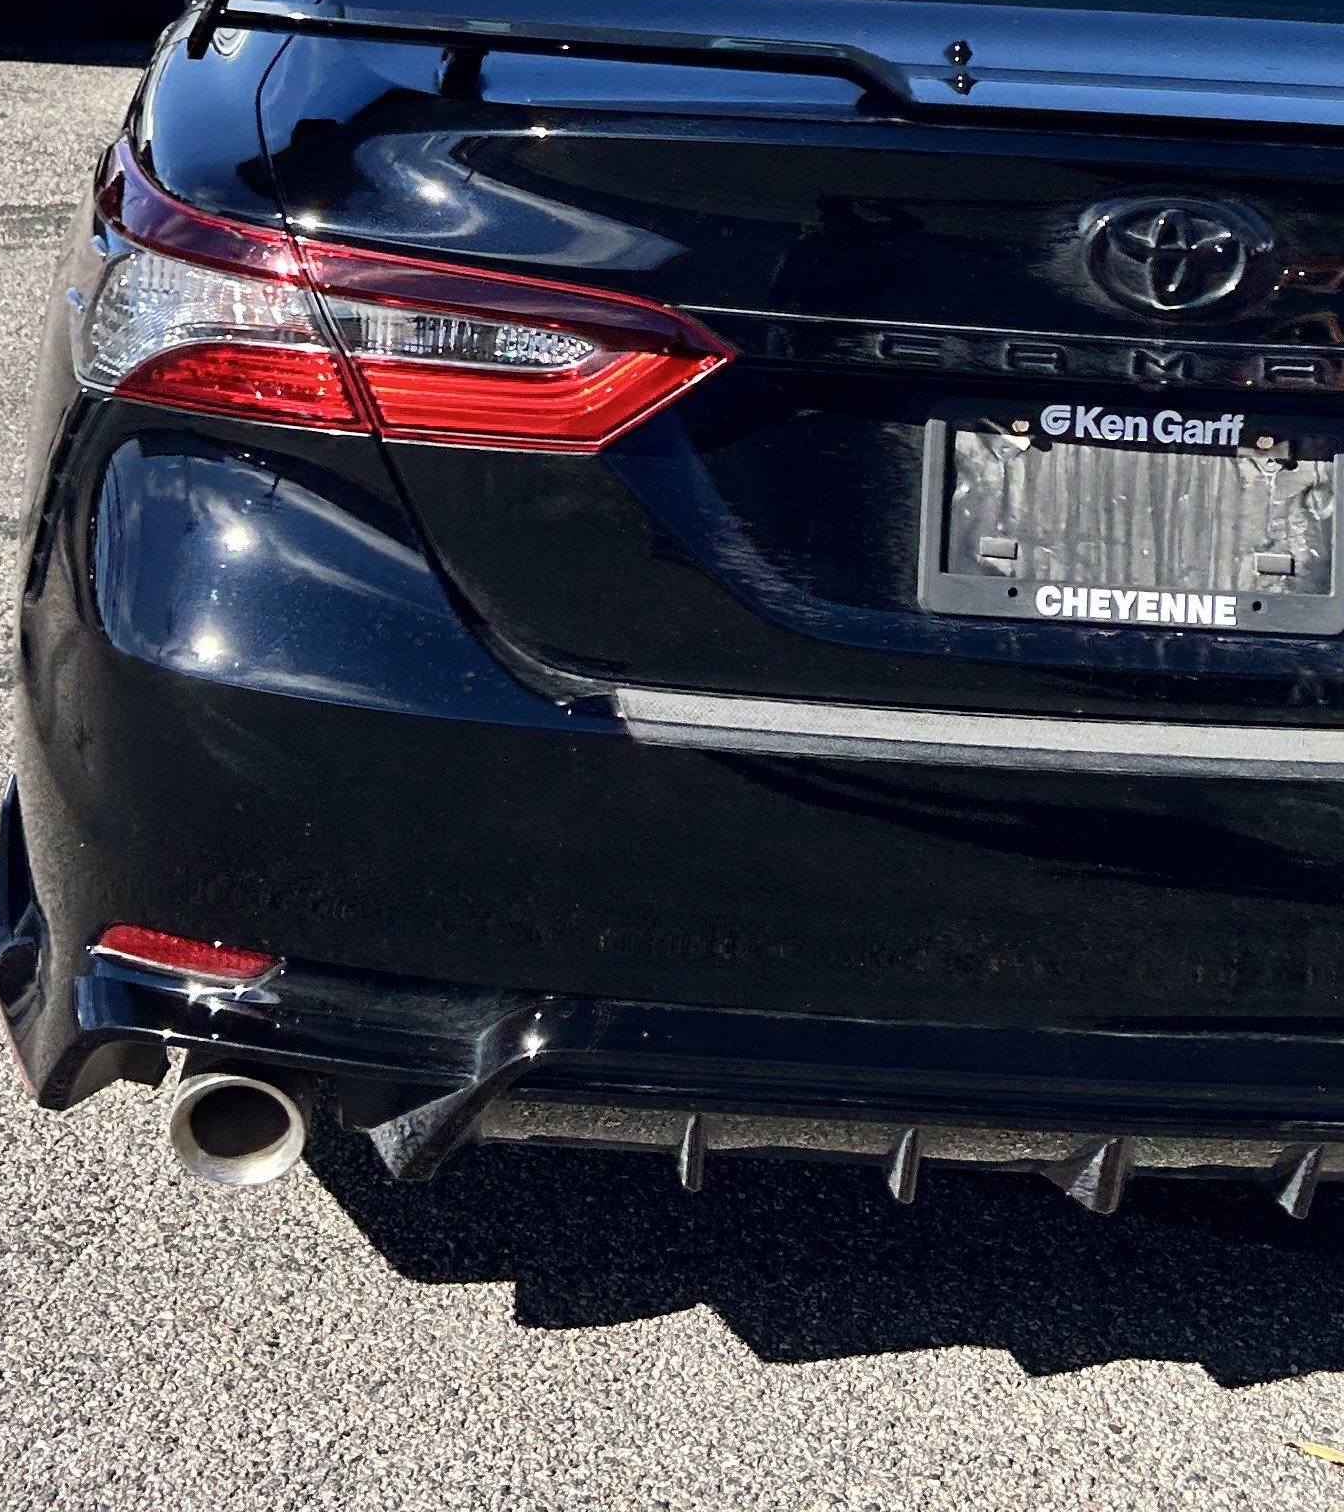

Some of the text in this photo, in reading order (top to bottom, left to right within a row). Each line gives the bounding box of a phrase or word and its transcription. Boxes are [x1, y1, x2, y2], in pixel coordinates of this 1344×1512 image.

[1075, 405, 1244, 445] Ken Garff
[1035, 585, 1238, 626] CHEYENNE
